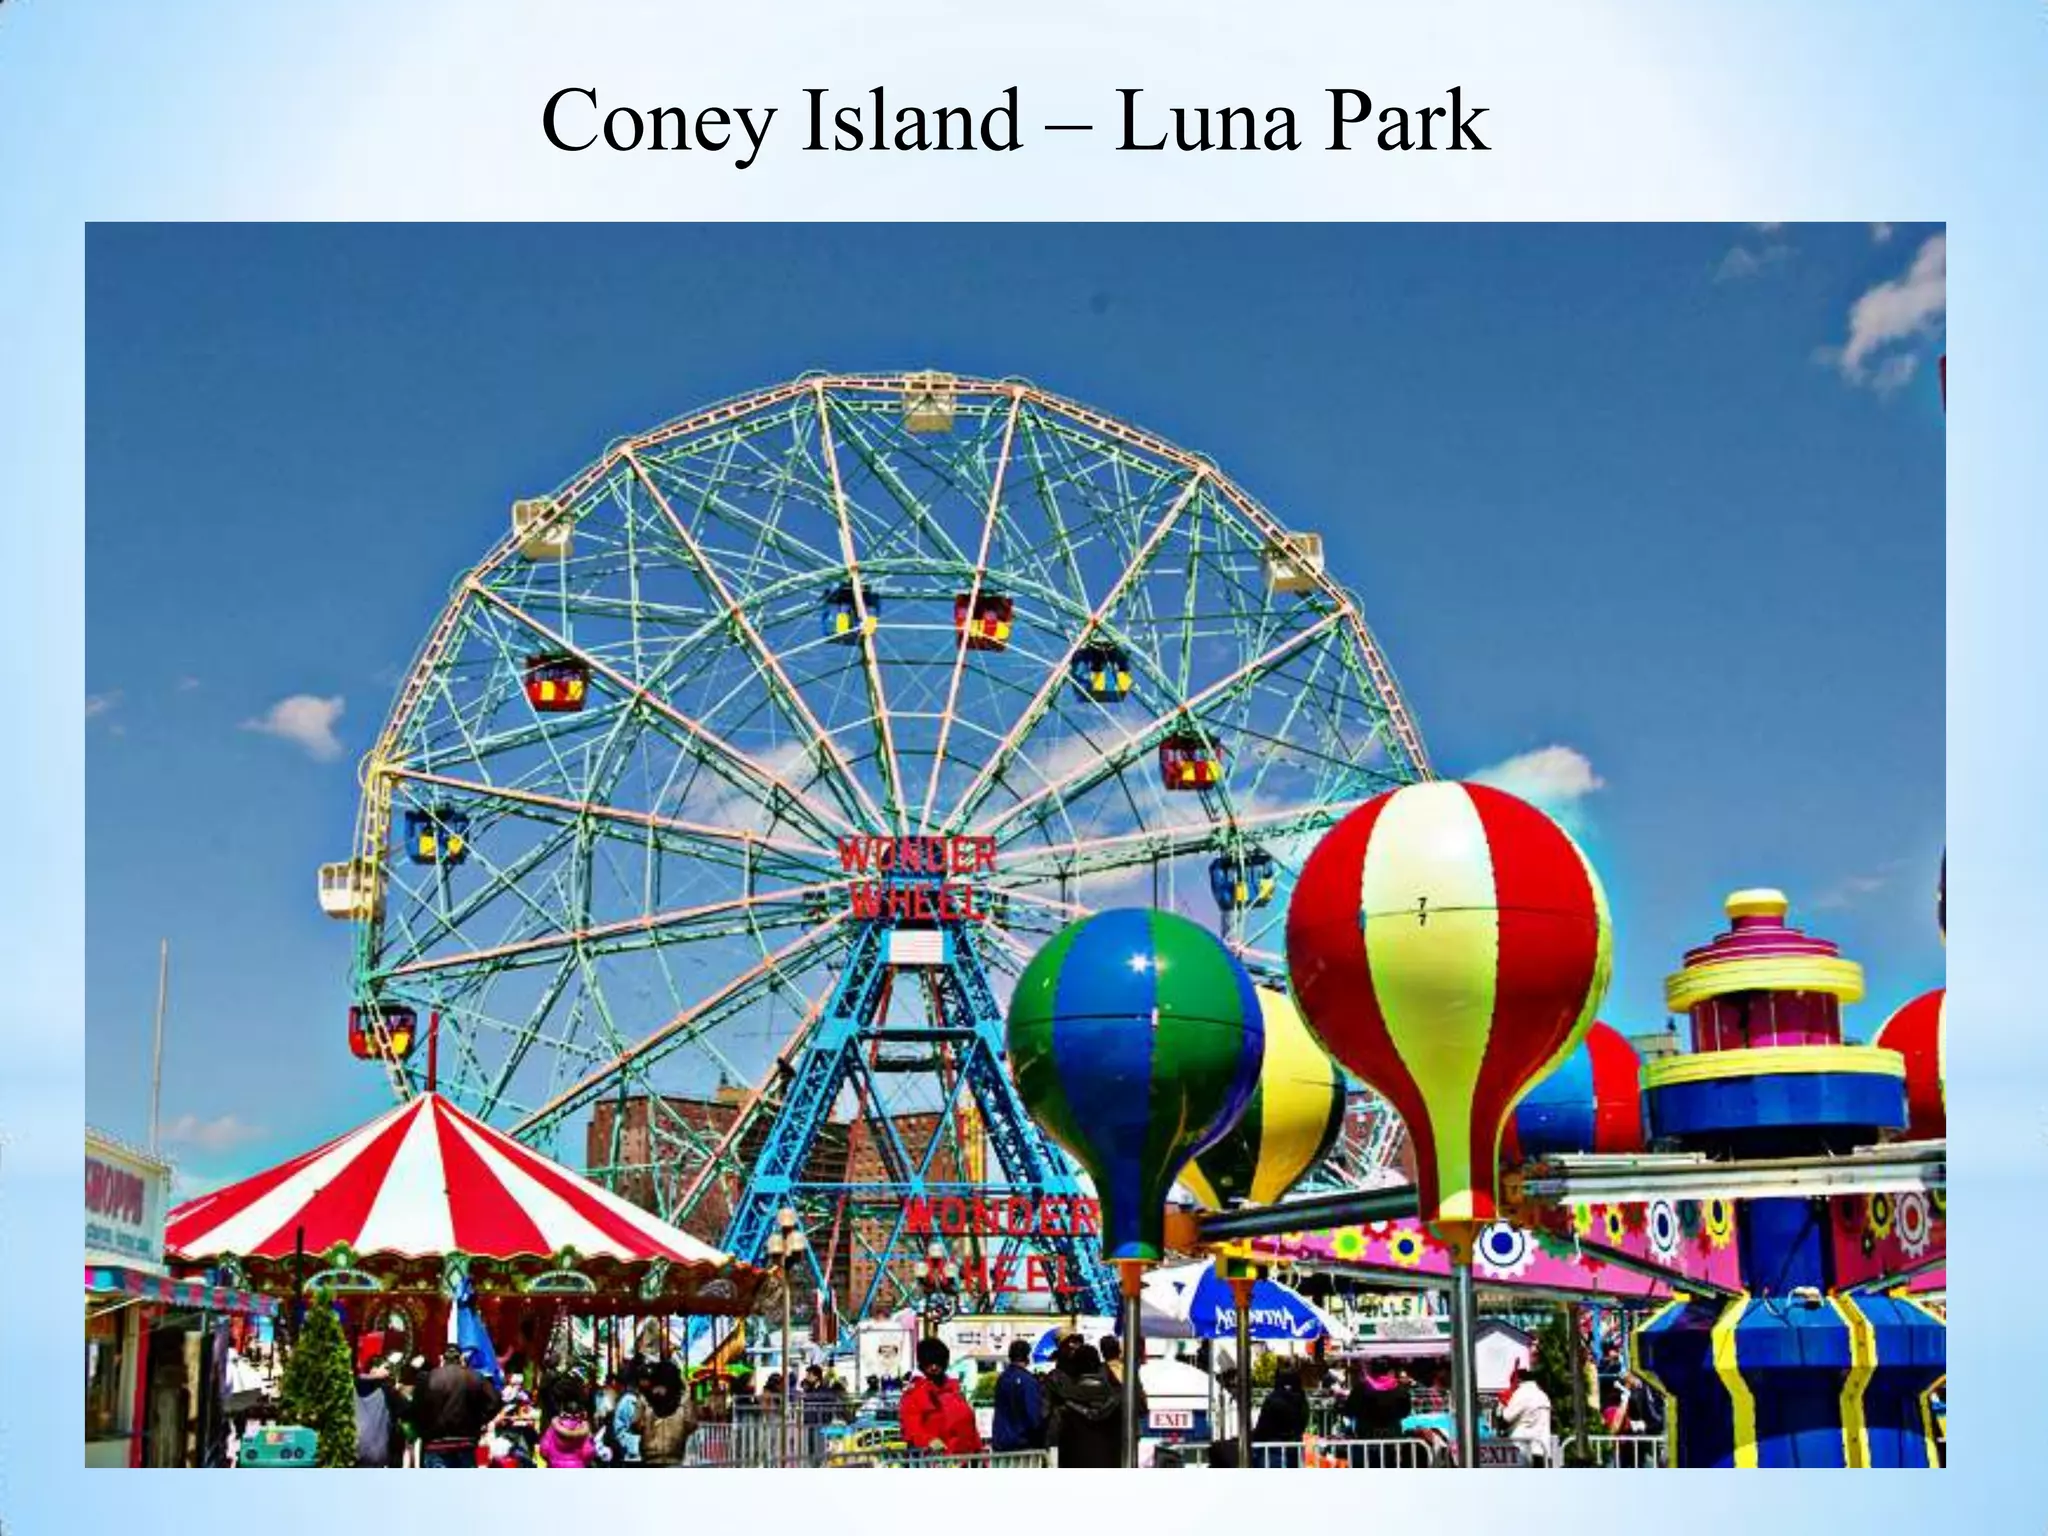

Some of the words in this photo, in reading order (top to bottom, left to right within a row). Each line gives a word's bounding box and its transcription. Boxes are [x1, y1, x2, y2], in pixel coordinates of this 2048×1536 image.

[837, 835, 997, 872] WONDER
[848, 881, 987, 920] WHEEL
[903, 1196, 1099, 1235] WONDER
[1154, 1413, 1188, 1427] EXIT
[1479, 1445, 1520, 1464] EXIT
